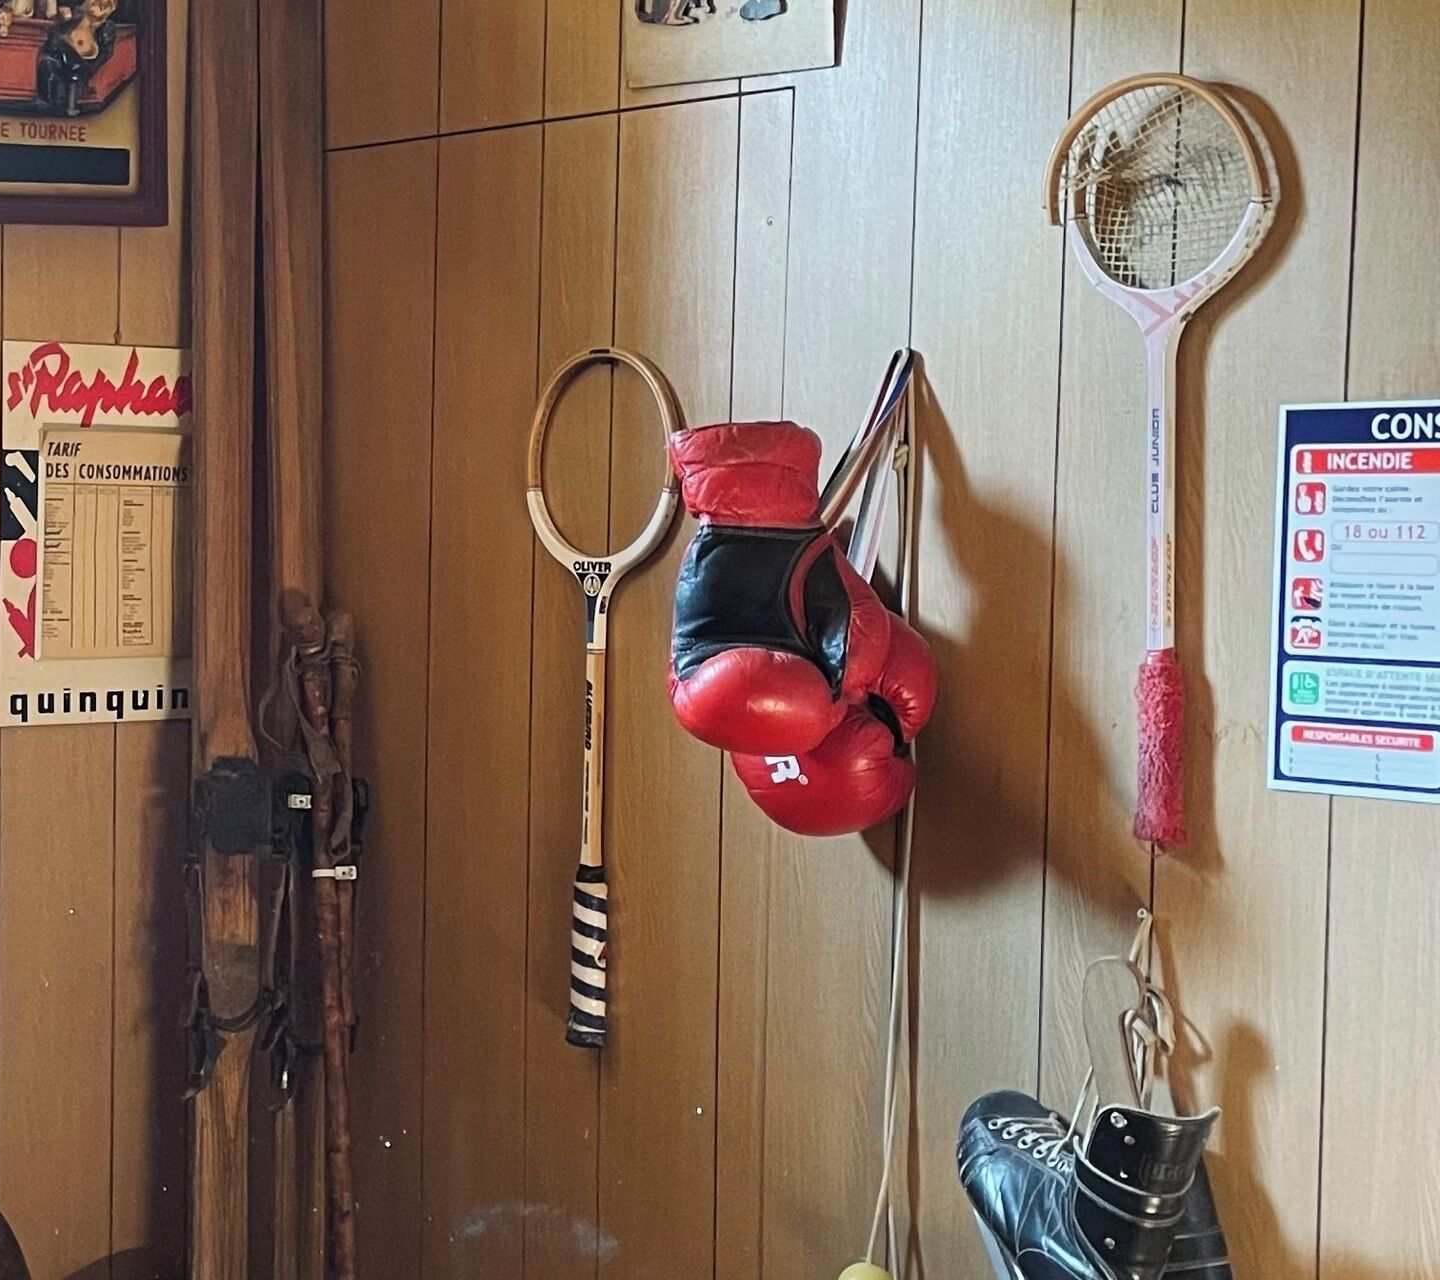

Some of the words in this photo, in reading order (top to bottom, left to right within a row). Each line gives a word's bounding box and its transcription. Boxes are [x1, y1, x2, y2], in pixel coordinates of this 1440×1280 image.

[19, 122, 86, 142] TOURNEE
[1152, 408, 1160, 466] JUNIOR
[47, 442, 82, 457] TARIF
[1327, 452, 1413, 470] INCENDIE
[46, 463, 69, 479] DES
[79, 463, 188, 482] CONSOMMATIONS
[1151, 473, 1159, 514] CLUB
[1345, 525, 1362, 539] 18
[1368, 528, 1388, 539] ou
[1397, 525, 1427, 539] 112
[573, 561, 612, 573] OLIVER
